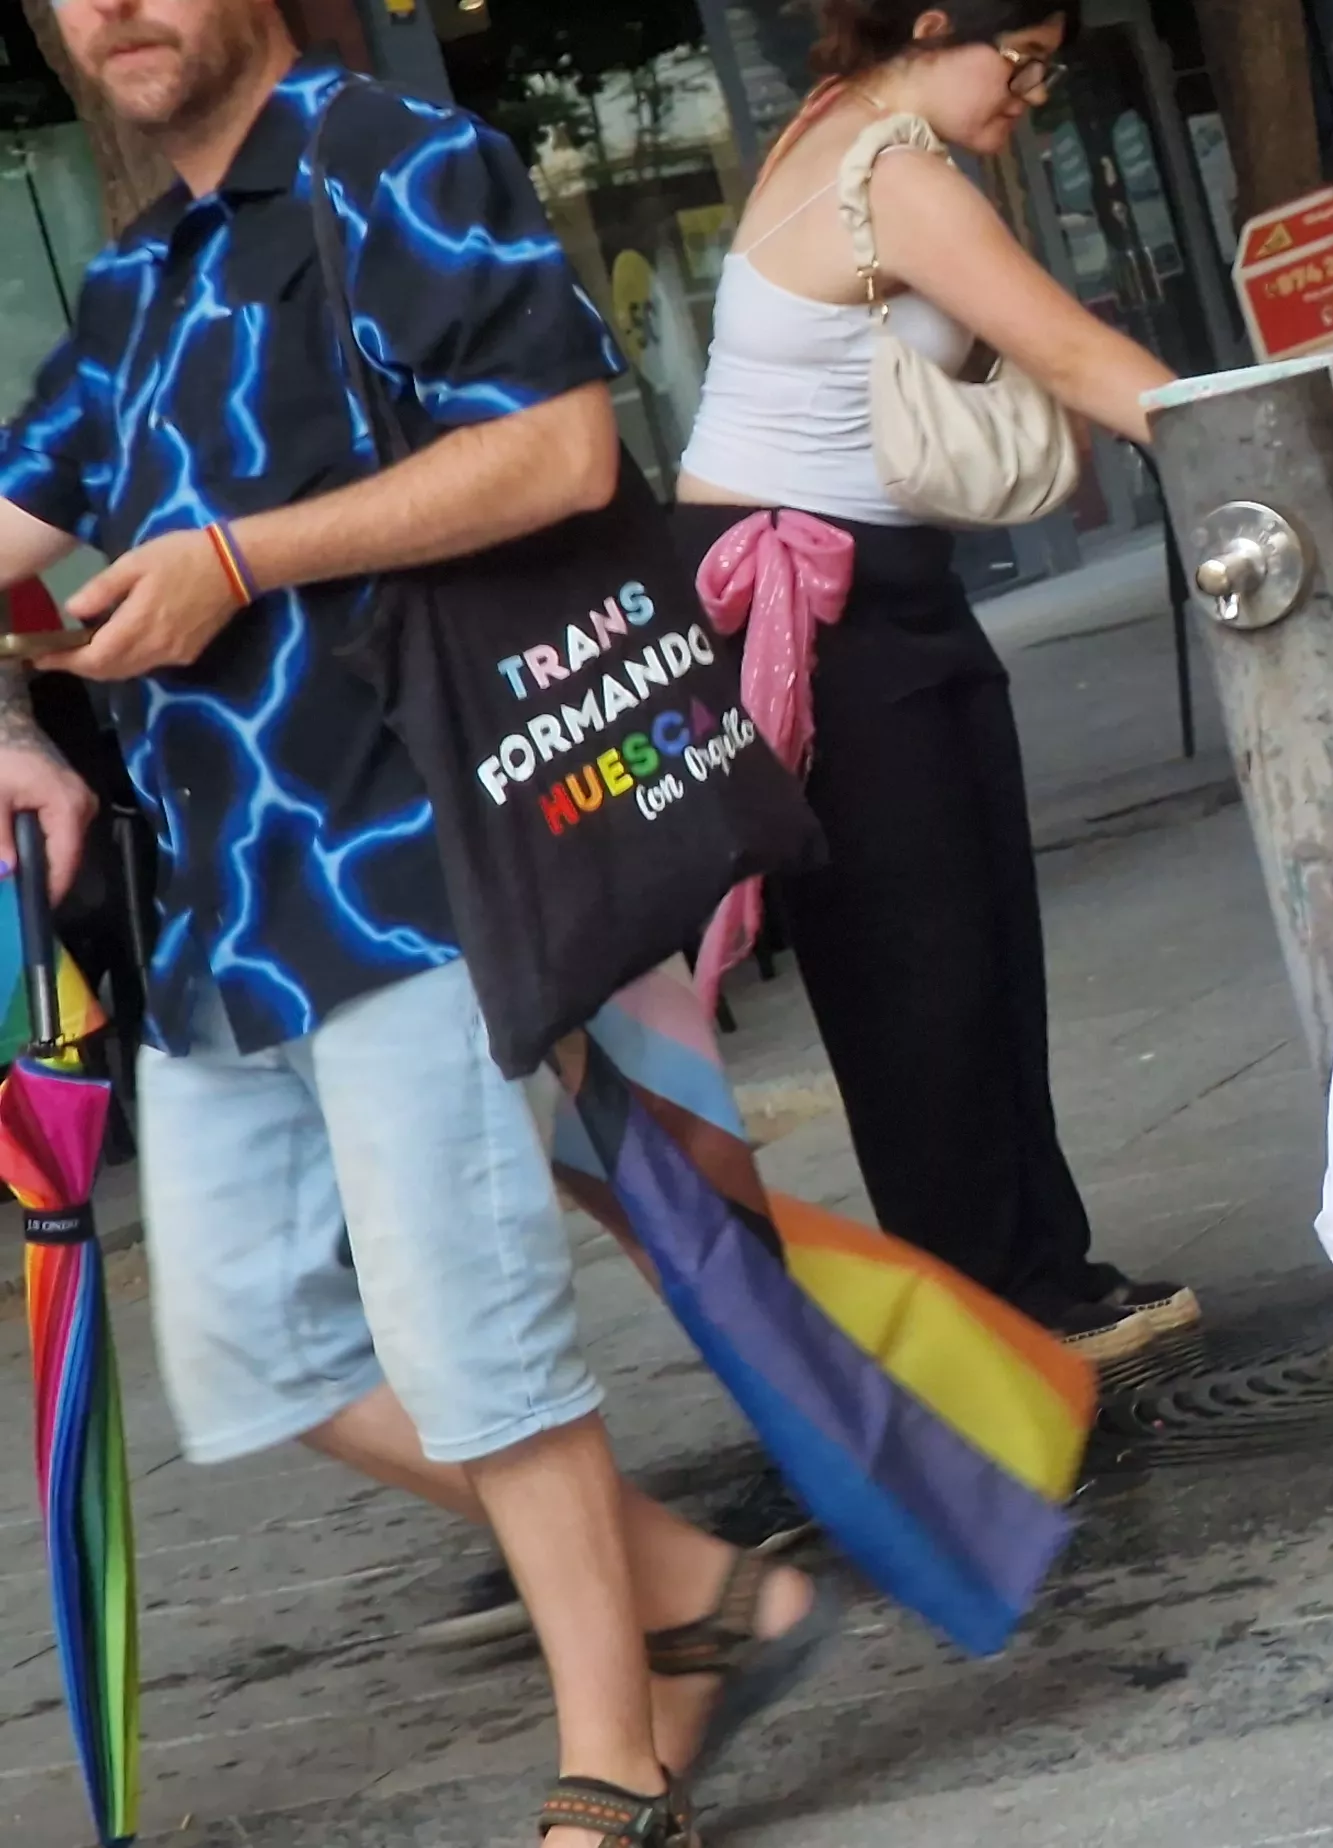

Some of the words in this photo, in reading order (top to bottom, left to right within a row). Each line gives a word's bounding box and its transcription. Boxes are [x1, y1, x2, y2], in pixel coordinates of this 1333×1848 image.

[498, 581, 655, 699] TRANS
[475, 622, 715, 806] FORMANDO
[539, 699, 716, 834] HUESCA
